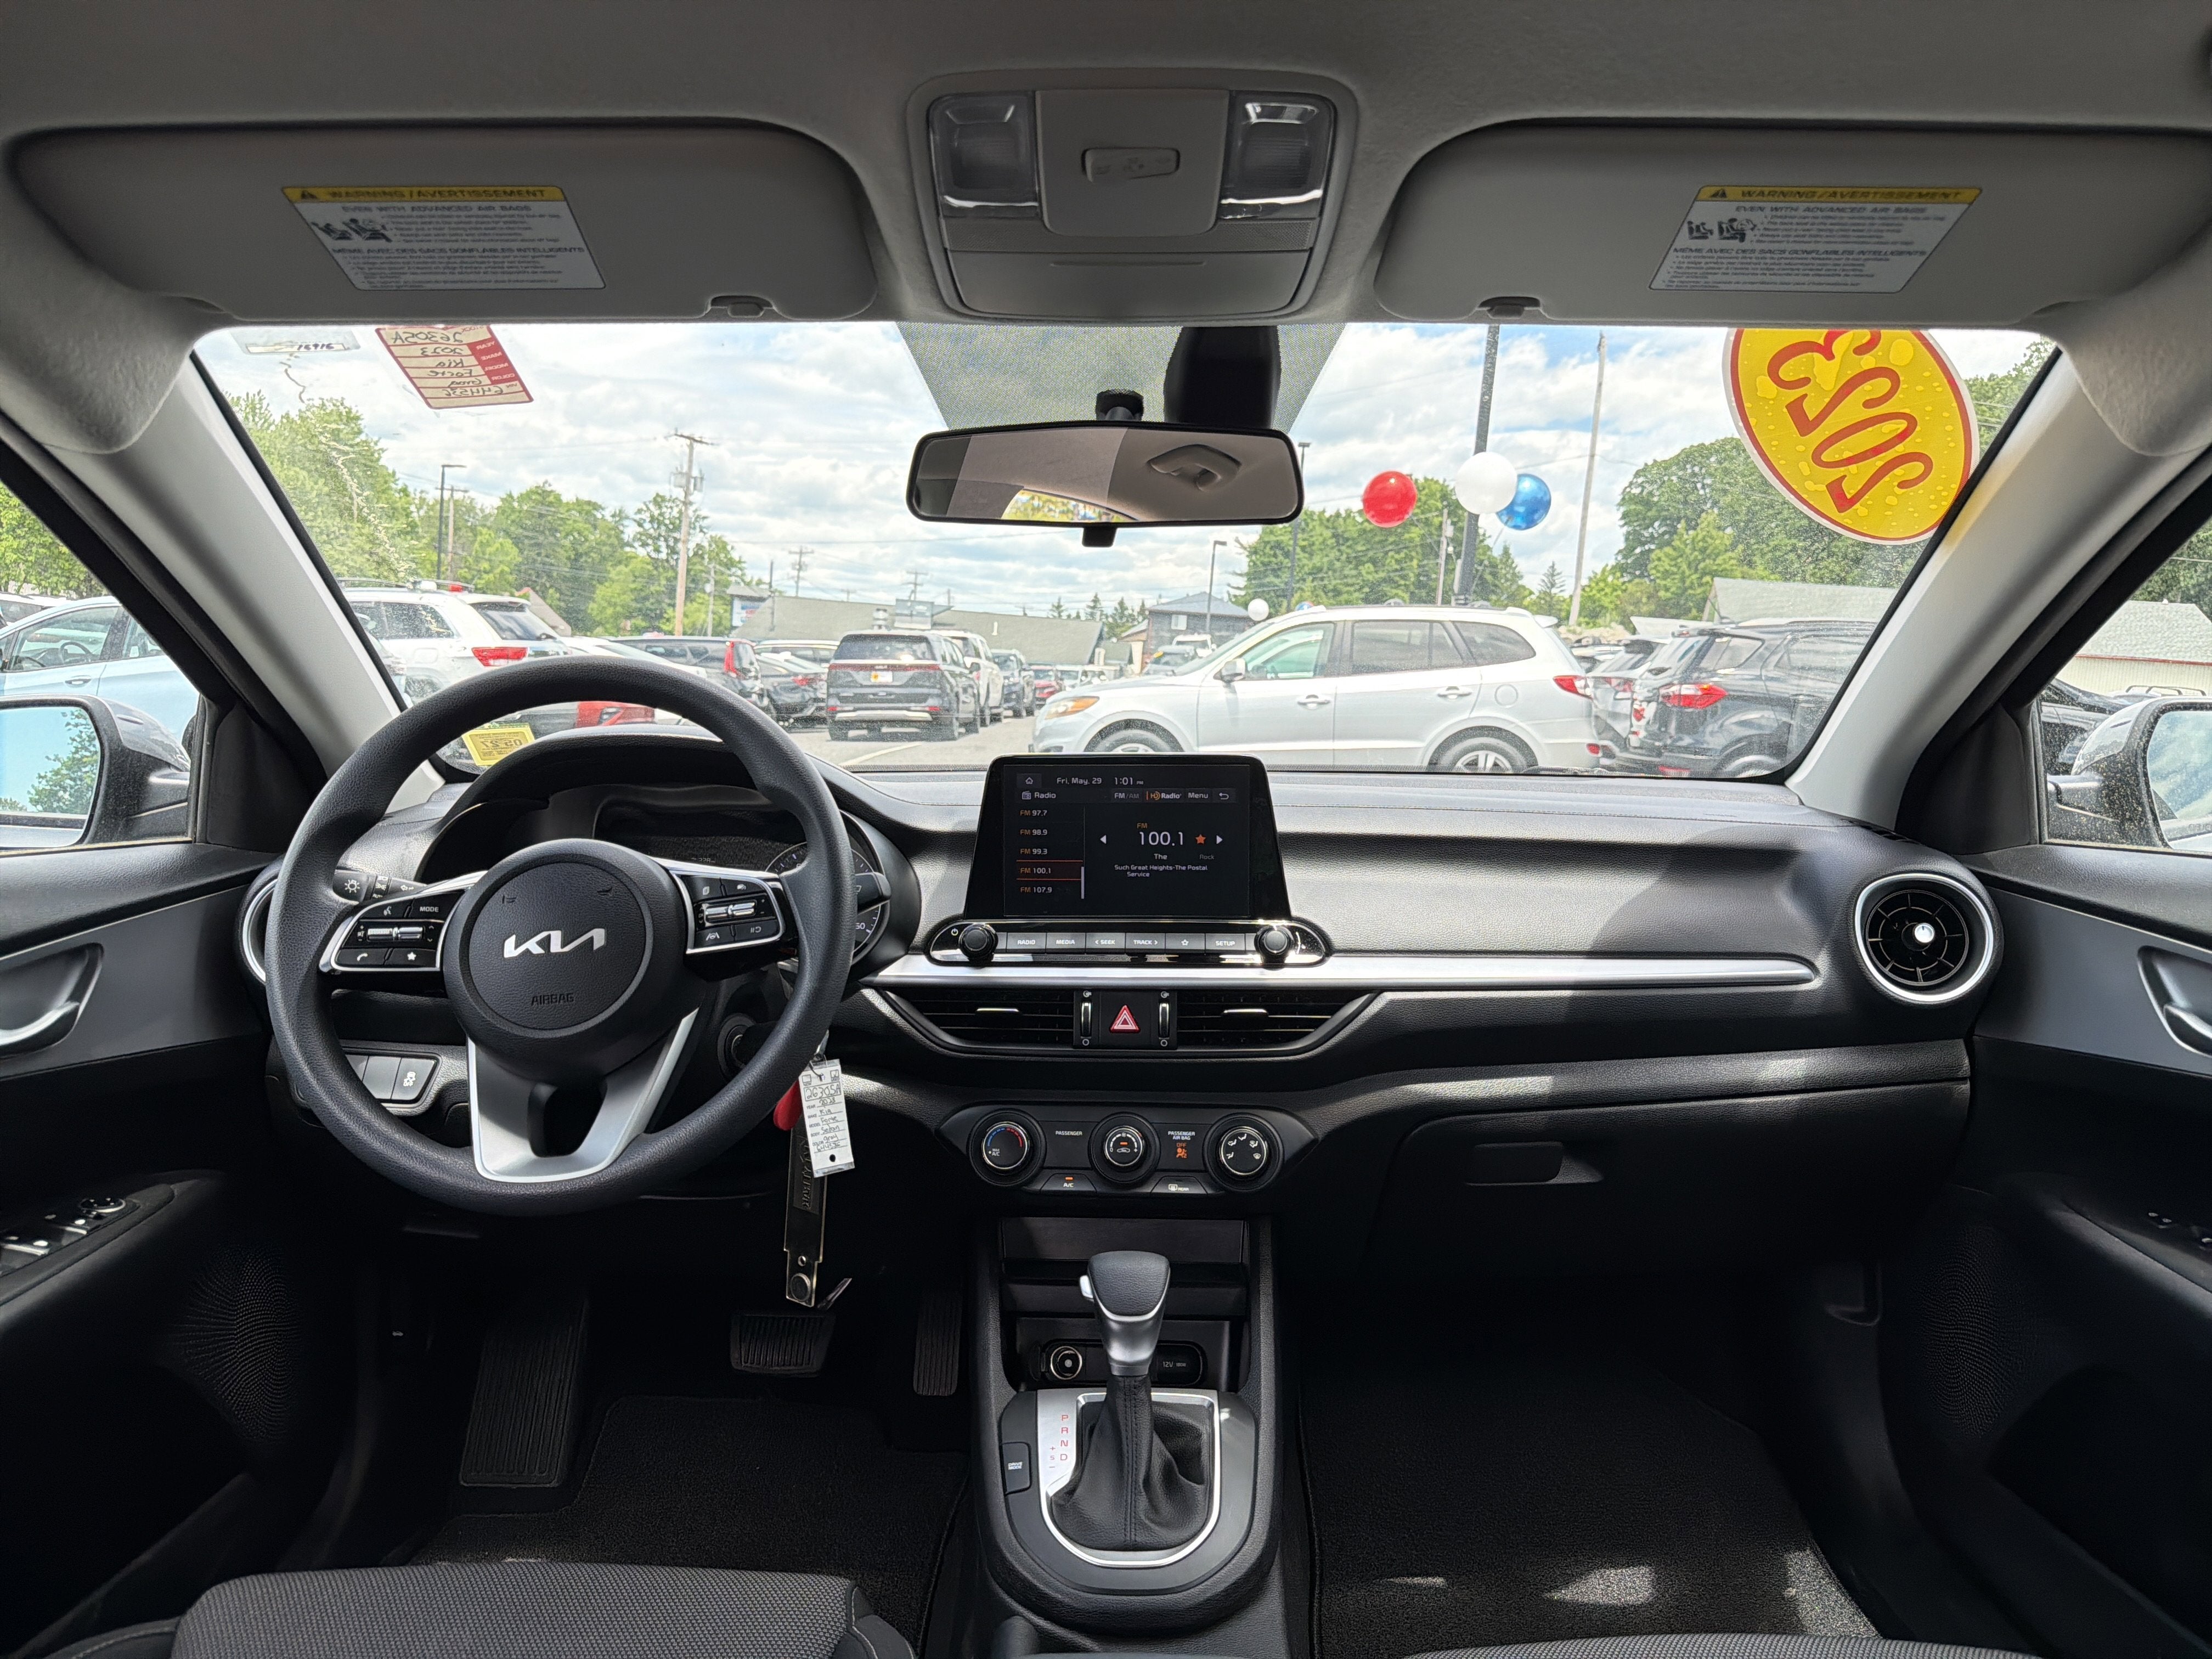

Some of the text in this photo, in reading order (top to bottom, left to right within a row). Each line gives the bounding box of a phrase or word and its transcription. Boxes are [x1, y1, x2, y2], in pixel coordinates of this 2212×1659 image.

[1114, 777, 1133, 785] 1:01
[1139, 832, 1183, 847] 100.1
[531, 993, 574, 1006] AIRBAG
